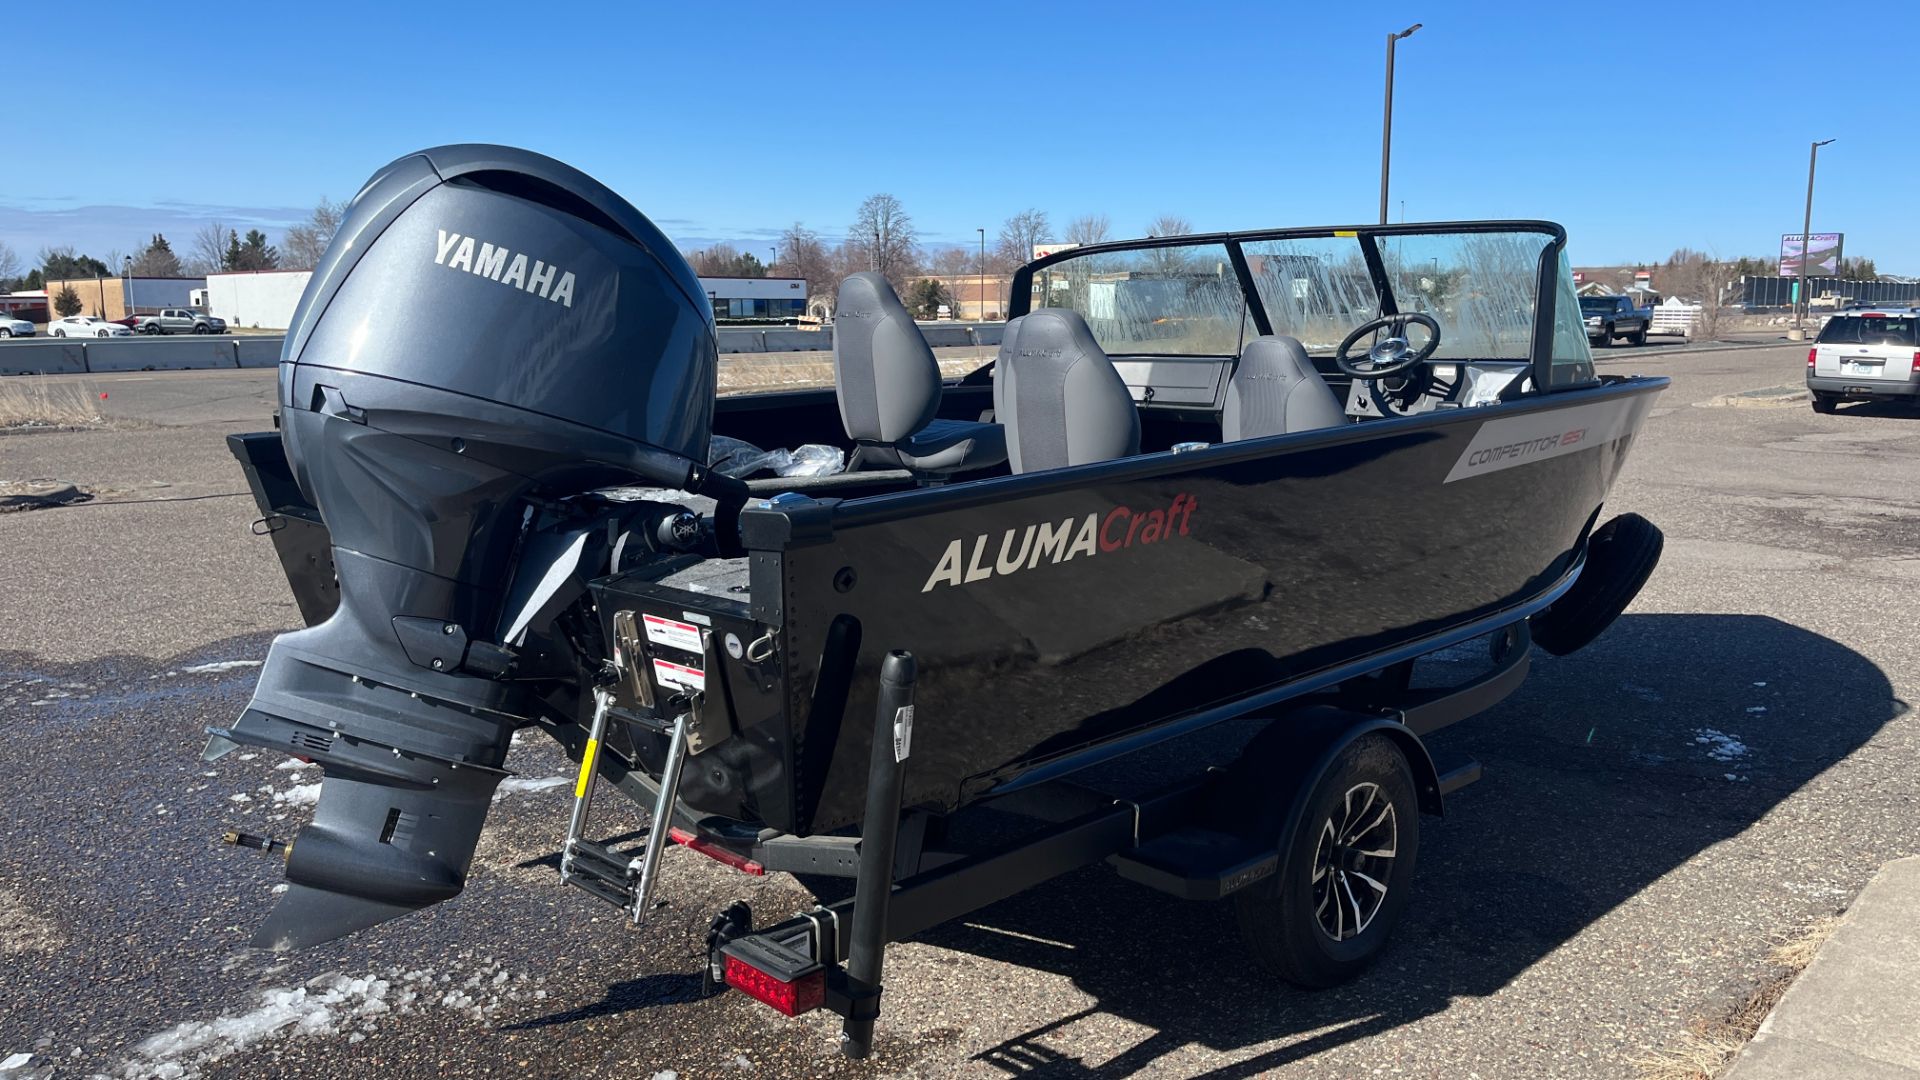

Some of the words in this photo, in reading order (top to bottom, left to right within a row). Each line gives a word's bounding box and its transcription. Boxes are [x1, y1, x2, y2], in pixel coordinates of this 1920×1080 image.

[434, 229, 576, 308] YAMAHA
[1468, 434, 1560, 466] COMPETITOR
[921, 493, 1198, 593] ALUMACraft
